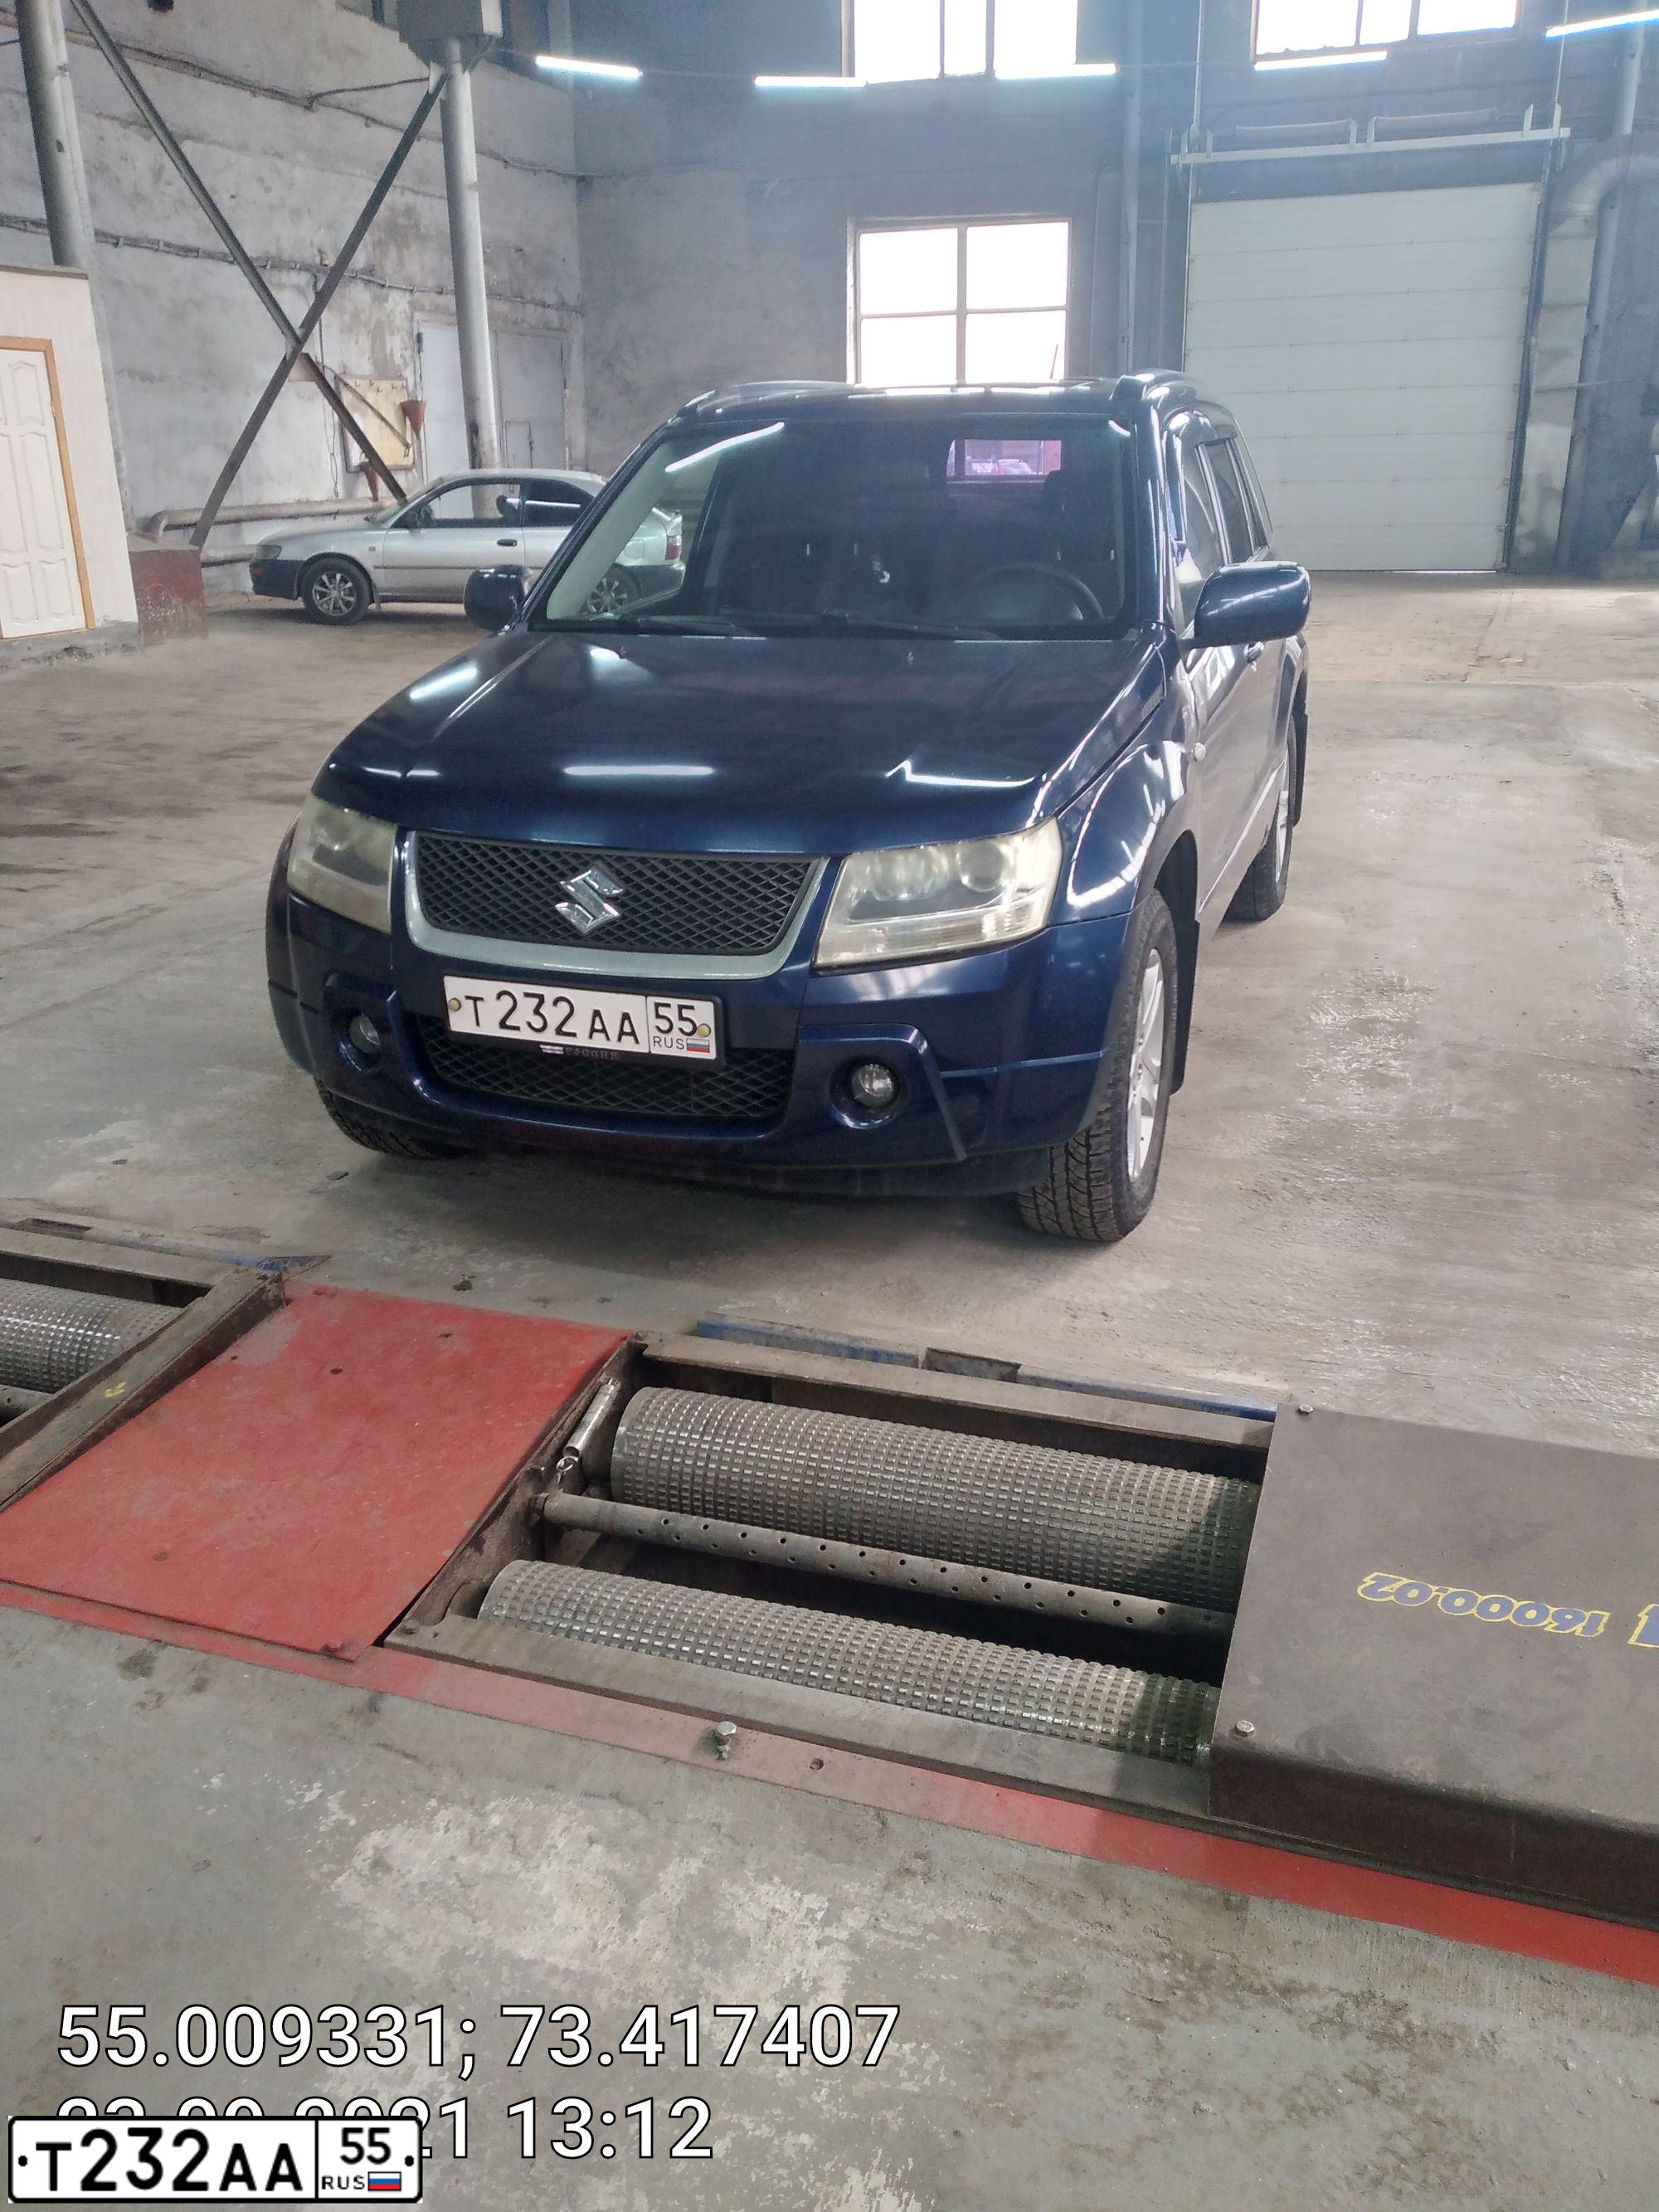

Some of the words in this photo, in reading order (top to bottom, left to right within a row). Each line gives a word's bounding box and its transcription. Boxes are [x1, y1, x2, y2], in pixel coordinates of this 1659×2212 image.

[465, 989, 640, 1045] Т232АА
[654, 1001, 698, 1037] 55
[653, 1037, 685, 1050] RUS
